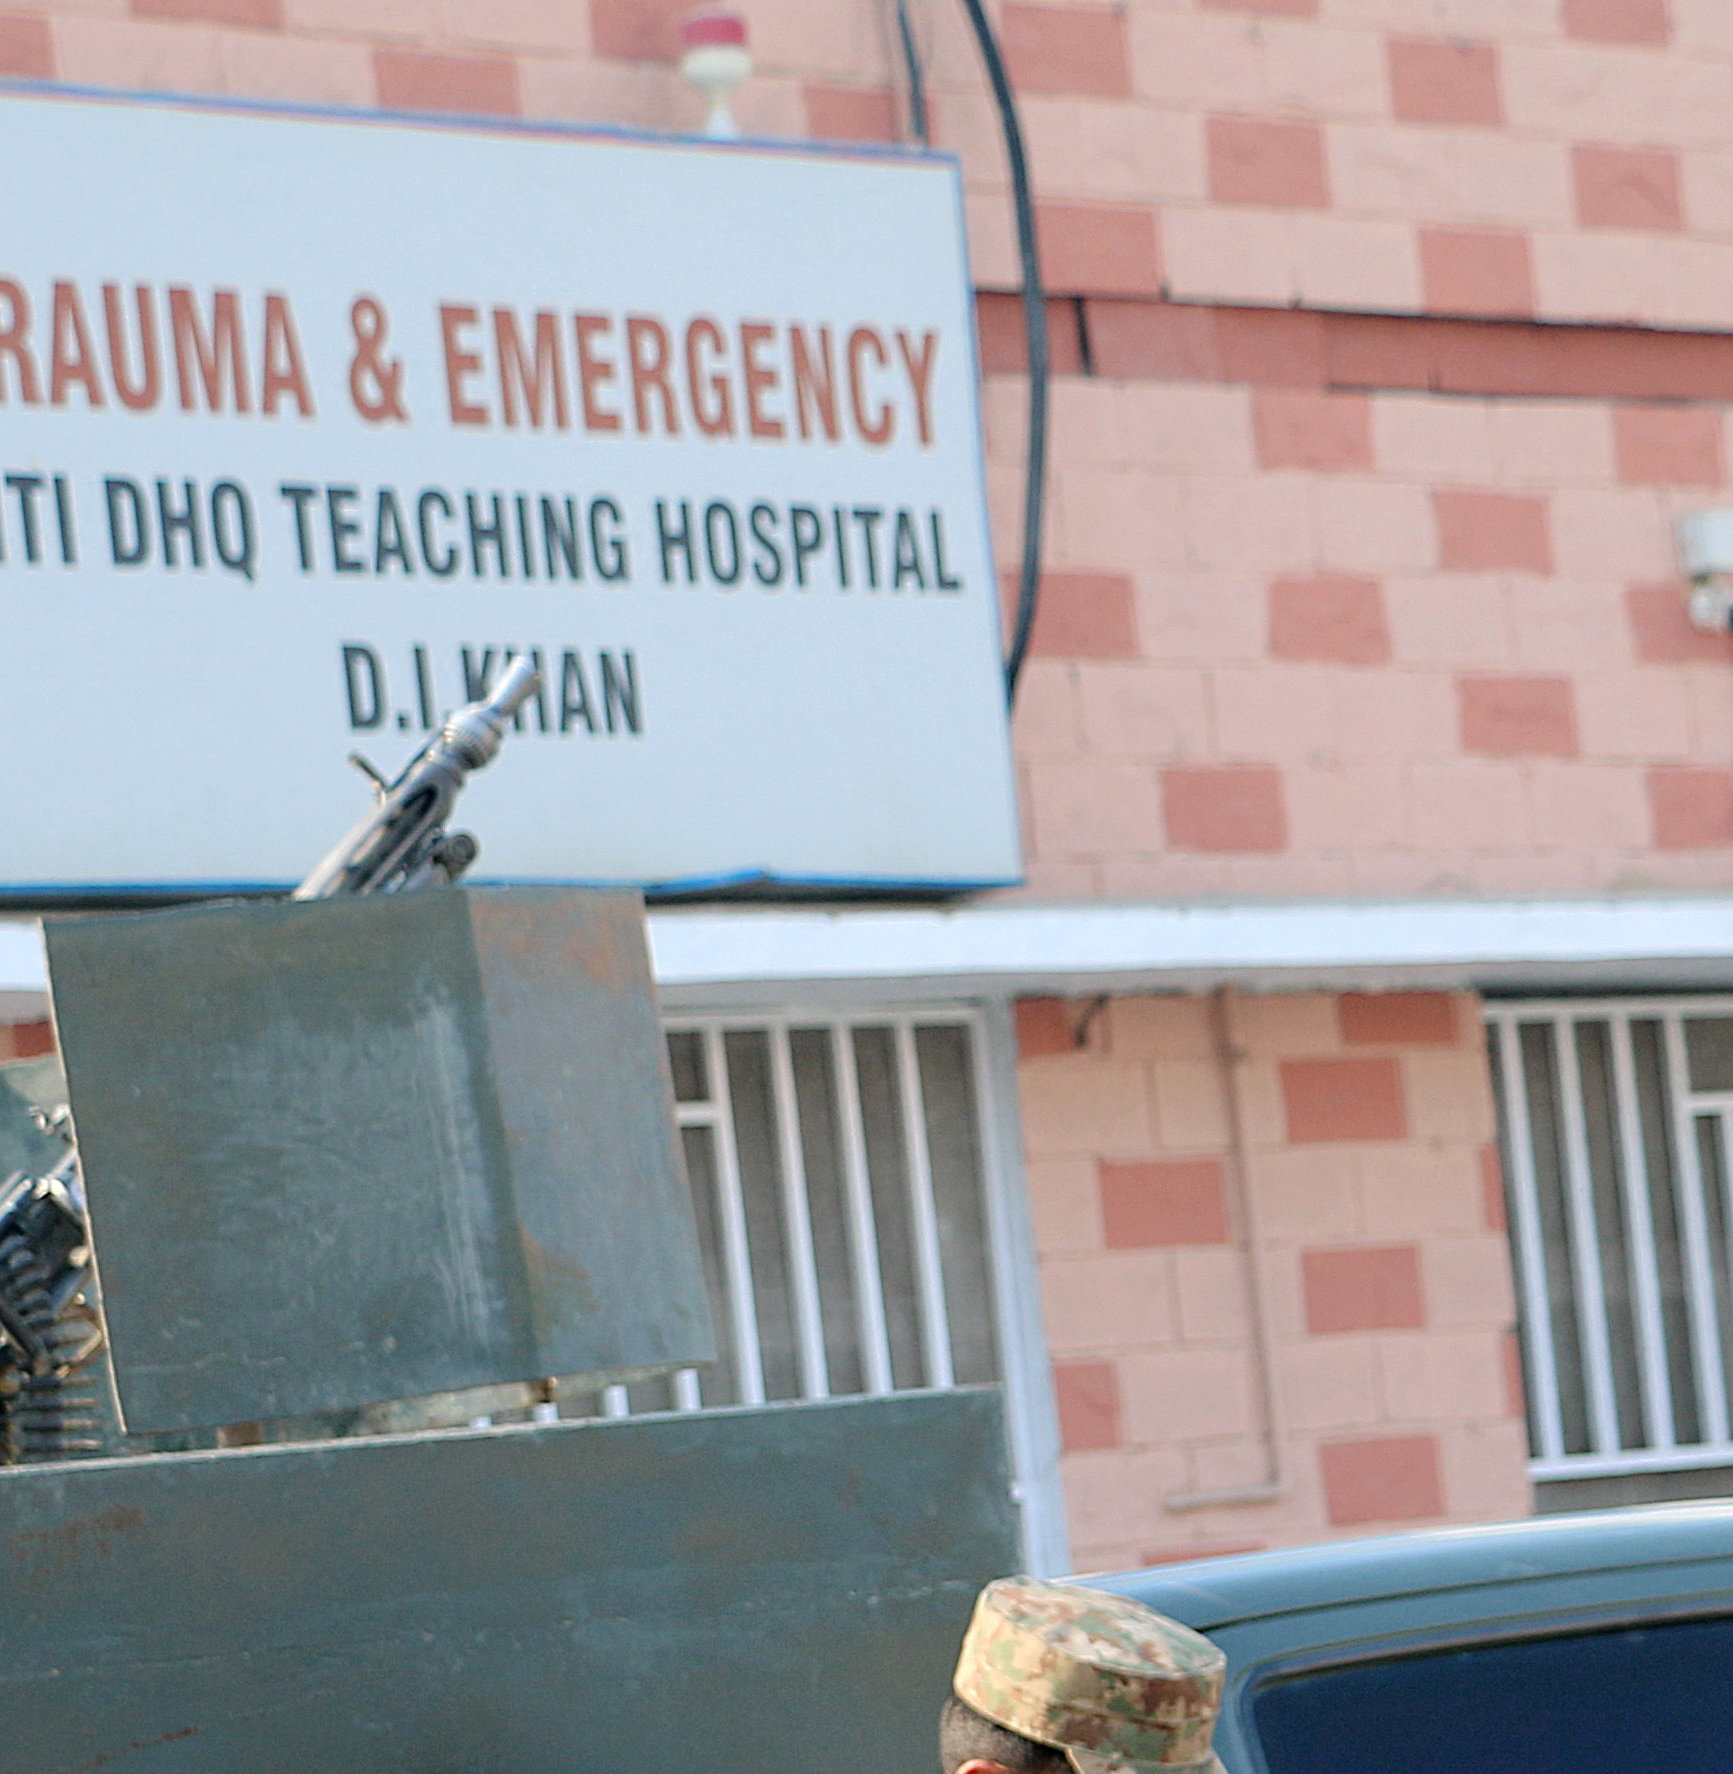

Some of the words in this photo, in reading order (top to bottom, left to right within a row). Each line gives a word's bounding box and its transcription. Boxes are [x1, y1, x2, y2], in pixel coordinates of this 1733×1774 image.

[350, 297, 410, 423] &
[440, 304, 936, 446] EMERGENCY
[104, 478, 256, 581] DHQ
[281, 485, 628, 582] TEACHING
[657, 499, 962, 592] HOSPITAL
